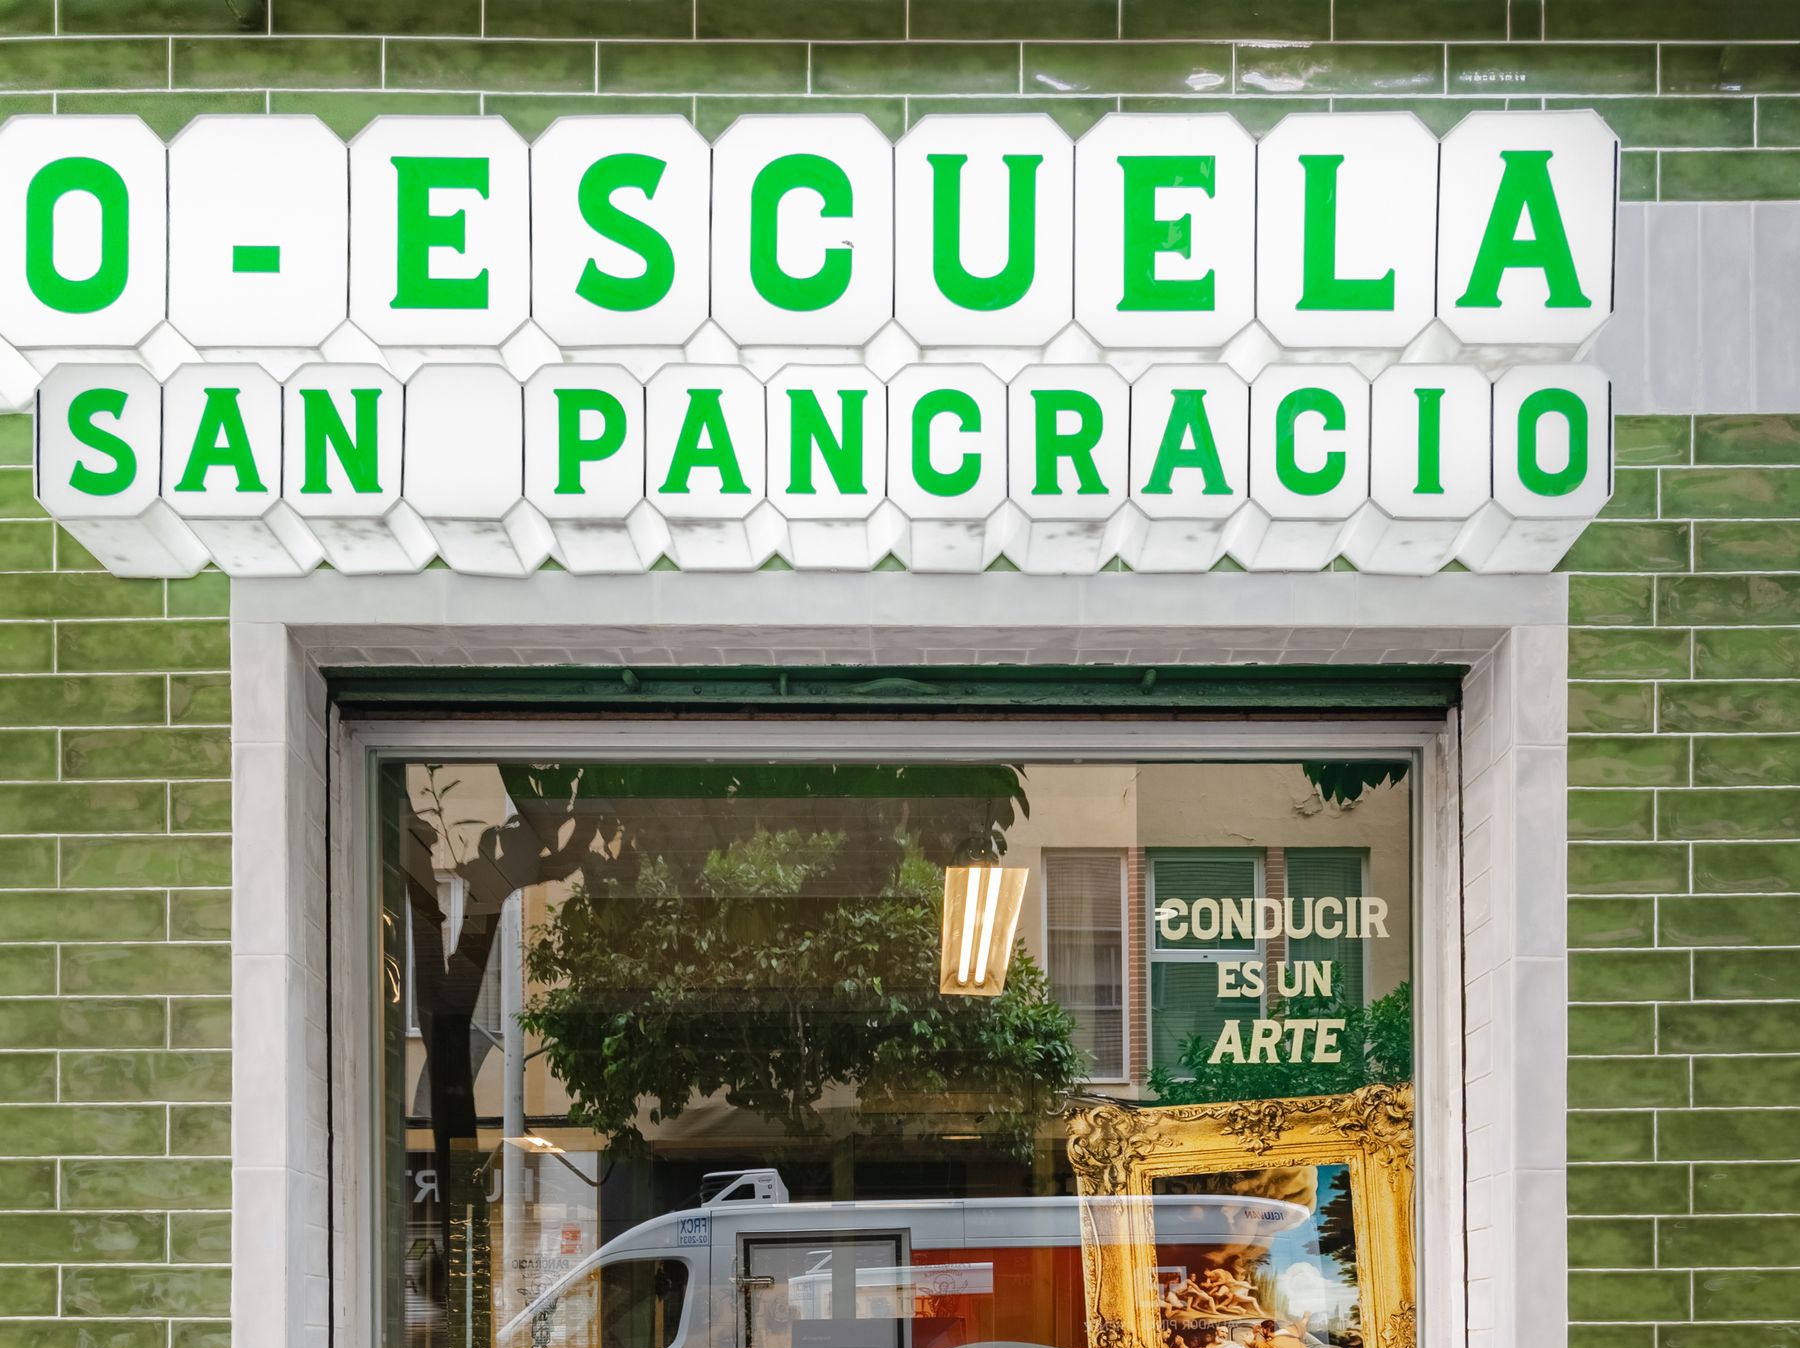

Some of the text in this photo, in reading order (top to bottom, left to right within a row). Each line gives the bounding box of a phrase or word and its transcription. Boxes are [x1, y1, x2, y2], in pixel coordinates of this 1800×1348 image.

[67, 386, 1588, 497] SAN PANCRACIO
[1158, 896, 1390, 941] CONDUCIR
[1216, 960, 1333, 998] ES UN
[1207, 1018, 1346, 1064] ARTE
